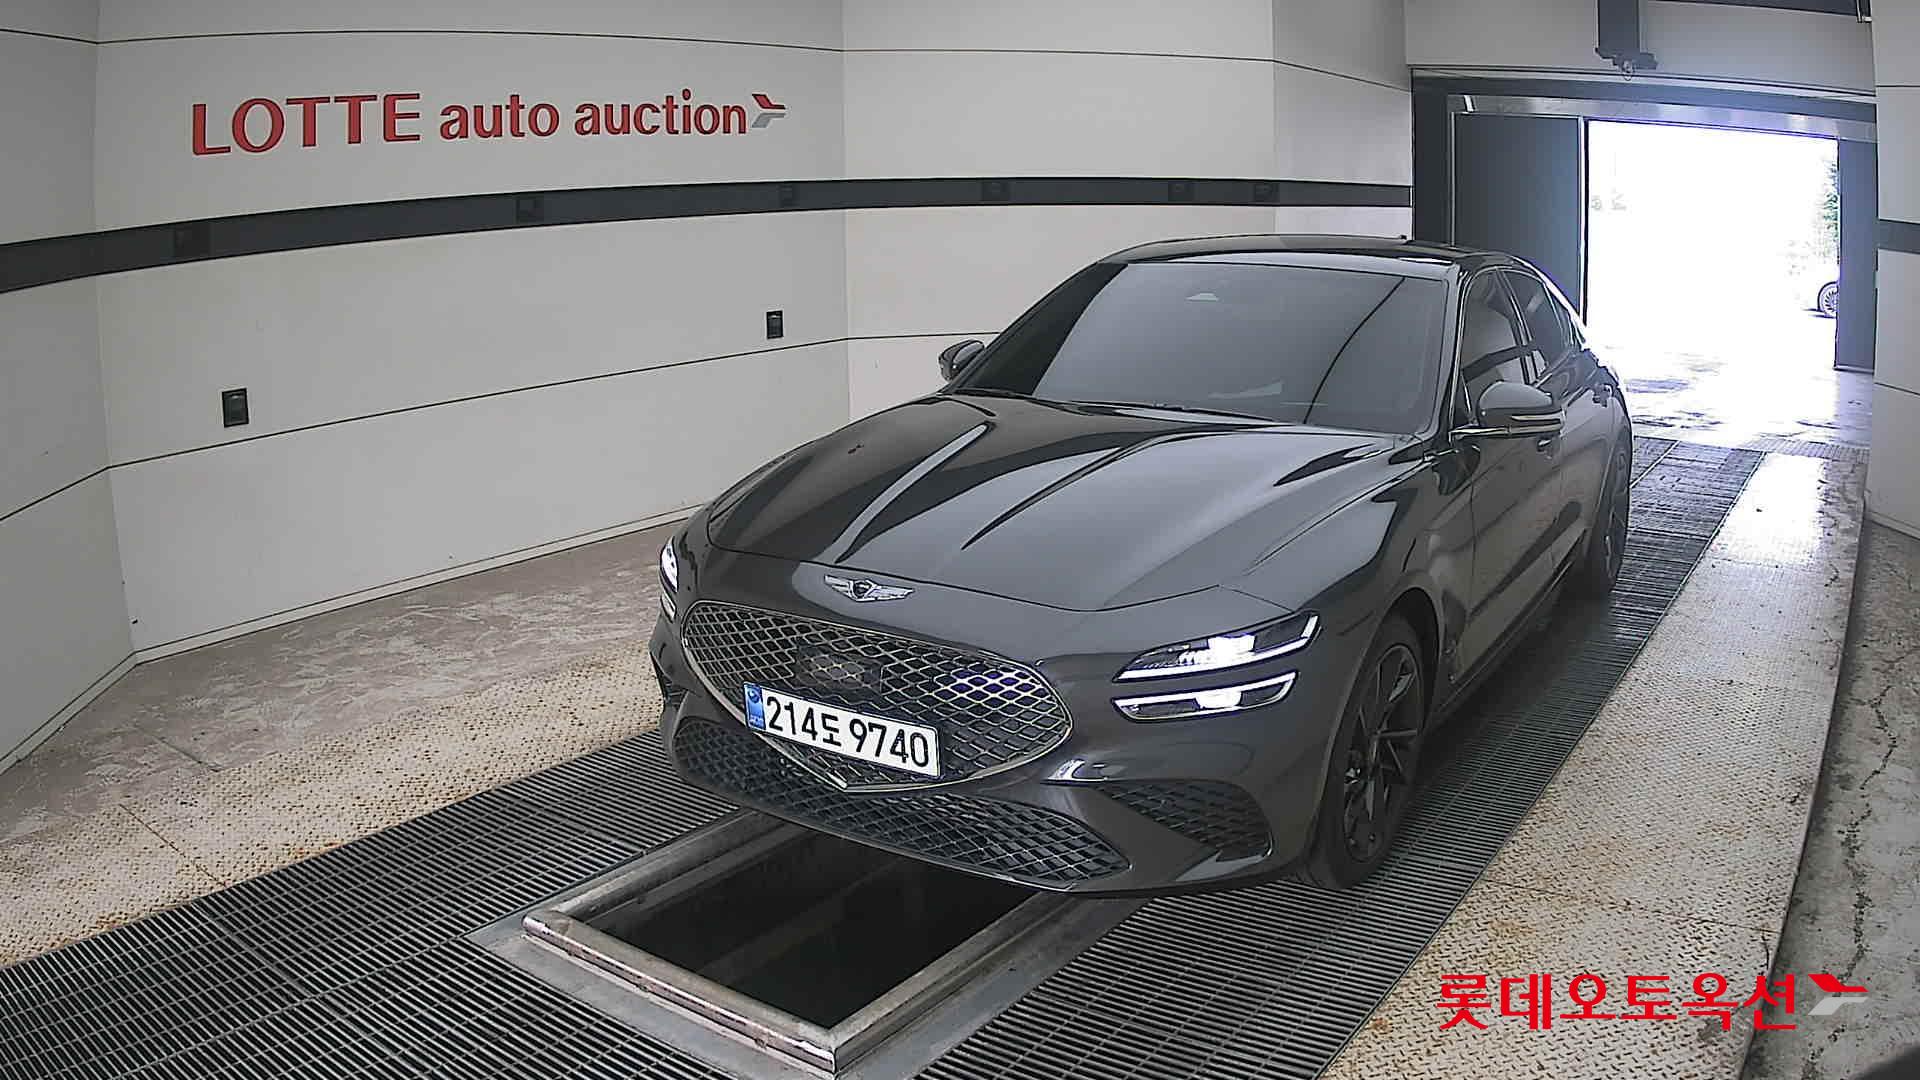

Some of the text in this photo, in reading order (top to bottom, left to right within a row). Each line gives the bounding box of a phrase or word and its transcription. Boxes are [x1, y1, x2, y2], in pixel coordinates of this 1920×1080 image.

[192, 89, 748, 156] LOTTE auto auction
